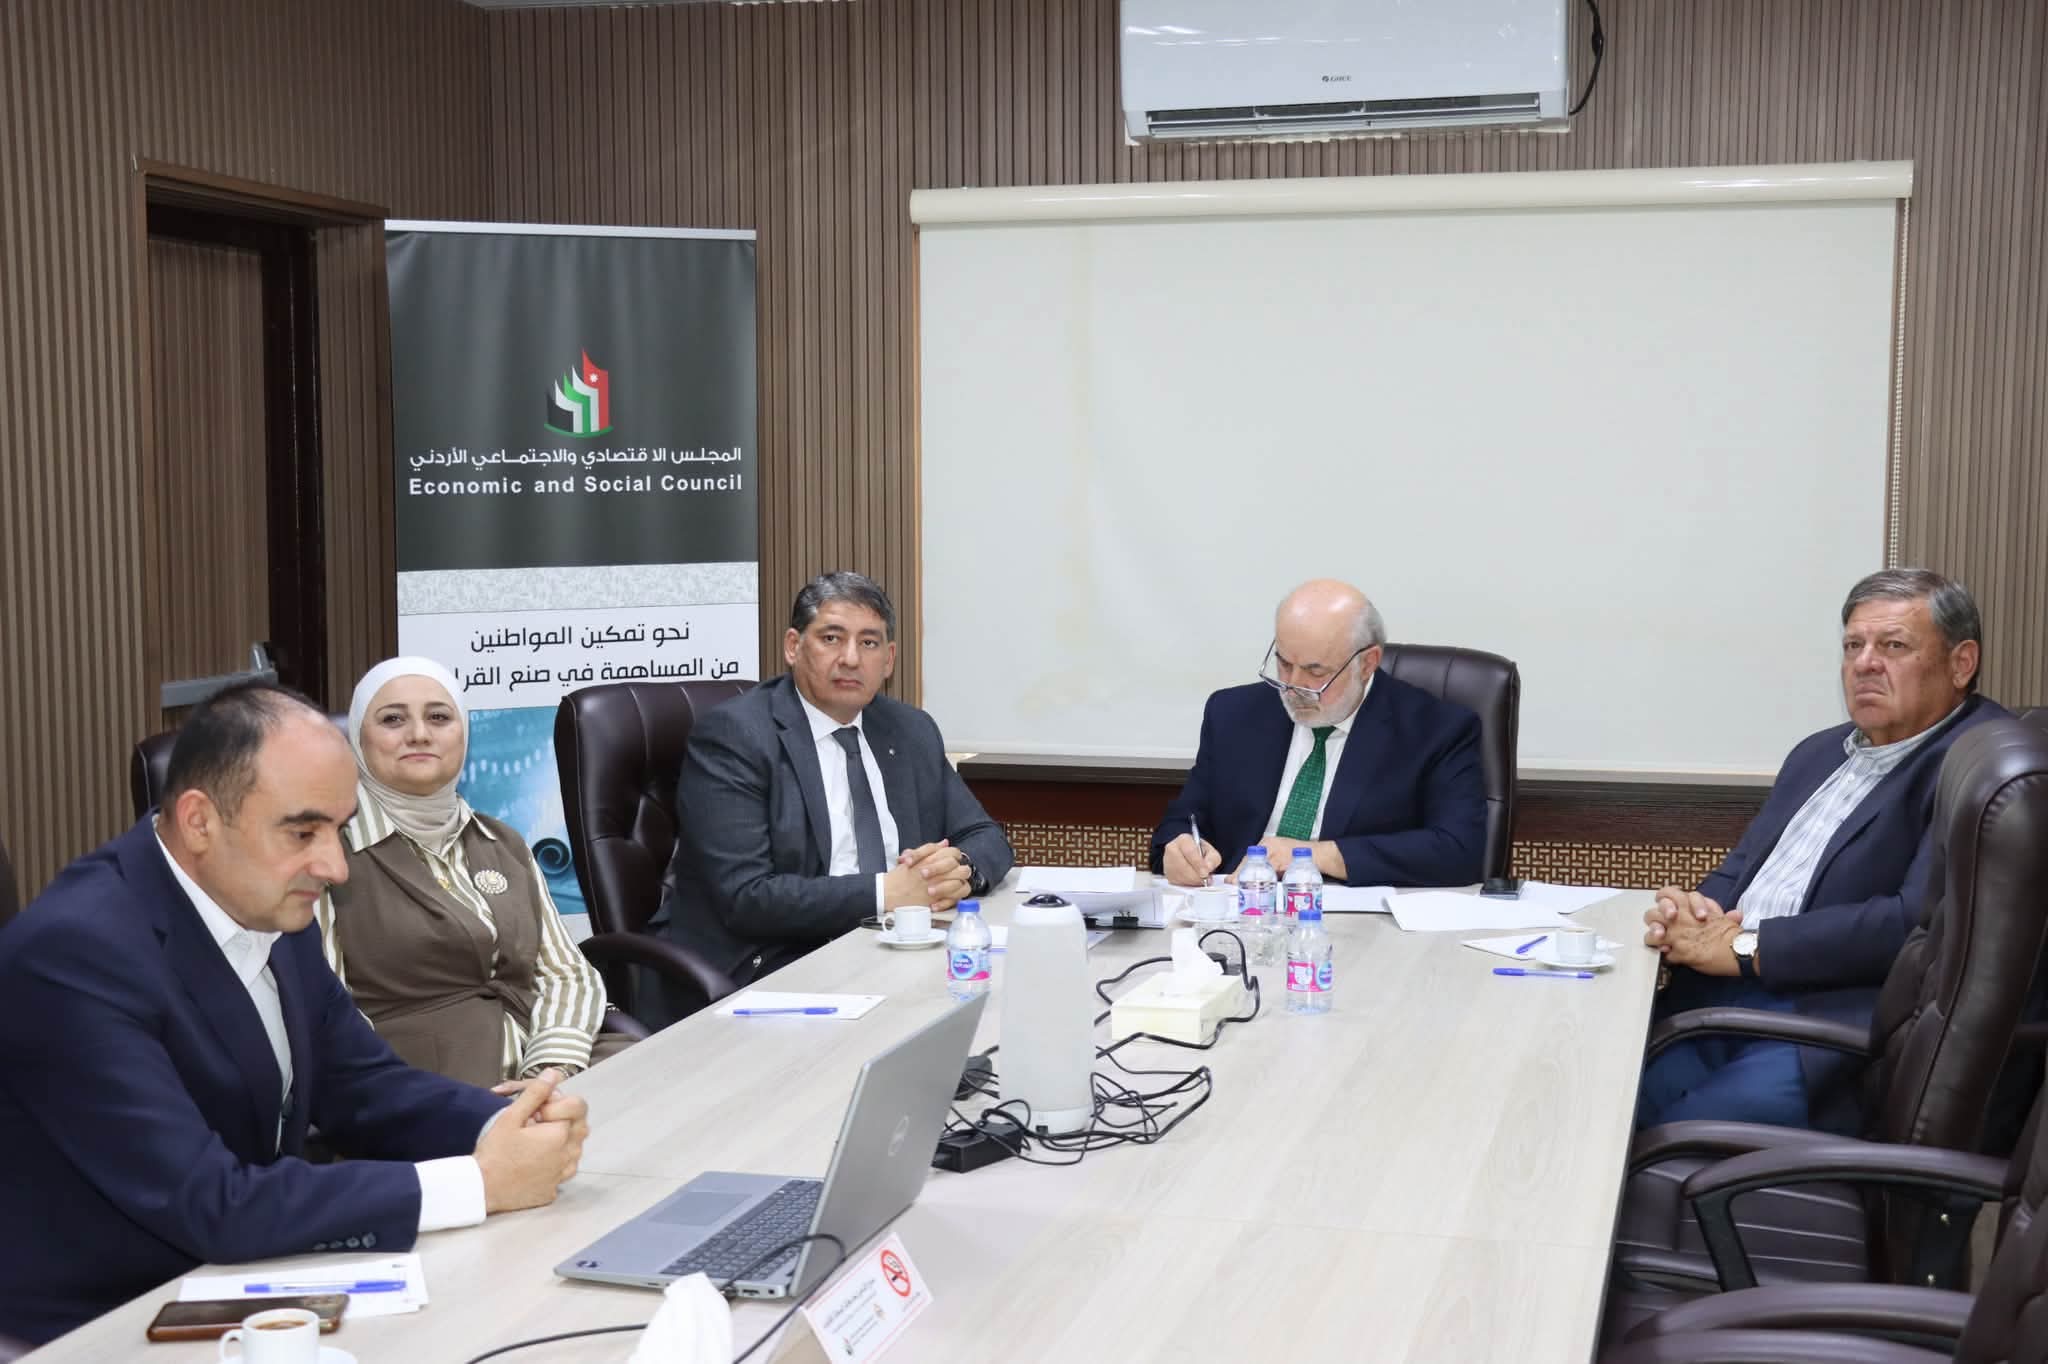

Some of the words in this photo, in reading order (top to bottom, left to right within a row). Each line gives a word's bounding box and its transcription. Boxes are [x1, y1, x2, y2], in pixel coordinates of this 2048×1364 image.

[409, 447, 467, 472] الأردني
[671, 447, 741, 465] المجلس
[409, 476, 522, 495] Economic
[534, 476, 575, 493] and
[584, 475, 652, 493] Social
[660, 474, 742, 492] Council
[470, 626, 572, 653] المواطنين
[581, 624, 645, 649] تمكين
[652, 622, 690, 648] نحو
[455, 665, 500, 692] القرا
[508, 664, 551, 692] صنع
[557, 663, 594, 688] في
[600, 657, 704, 681] المساهمة
[711, 658, 740, 679] من
